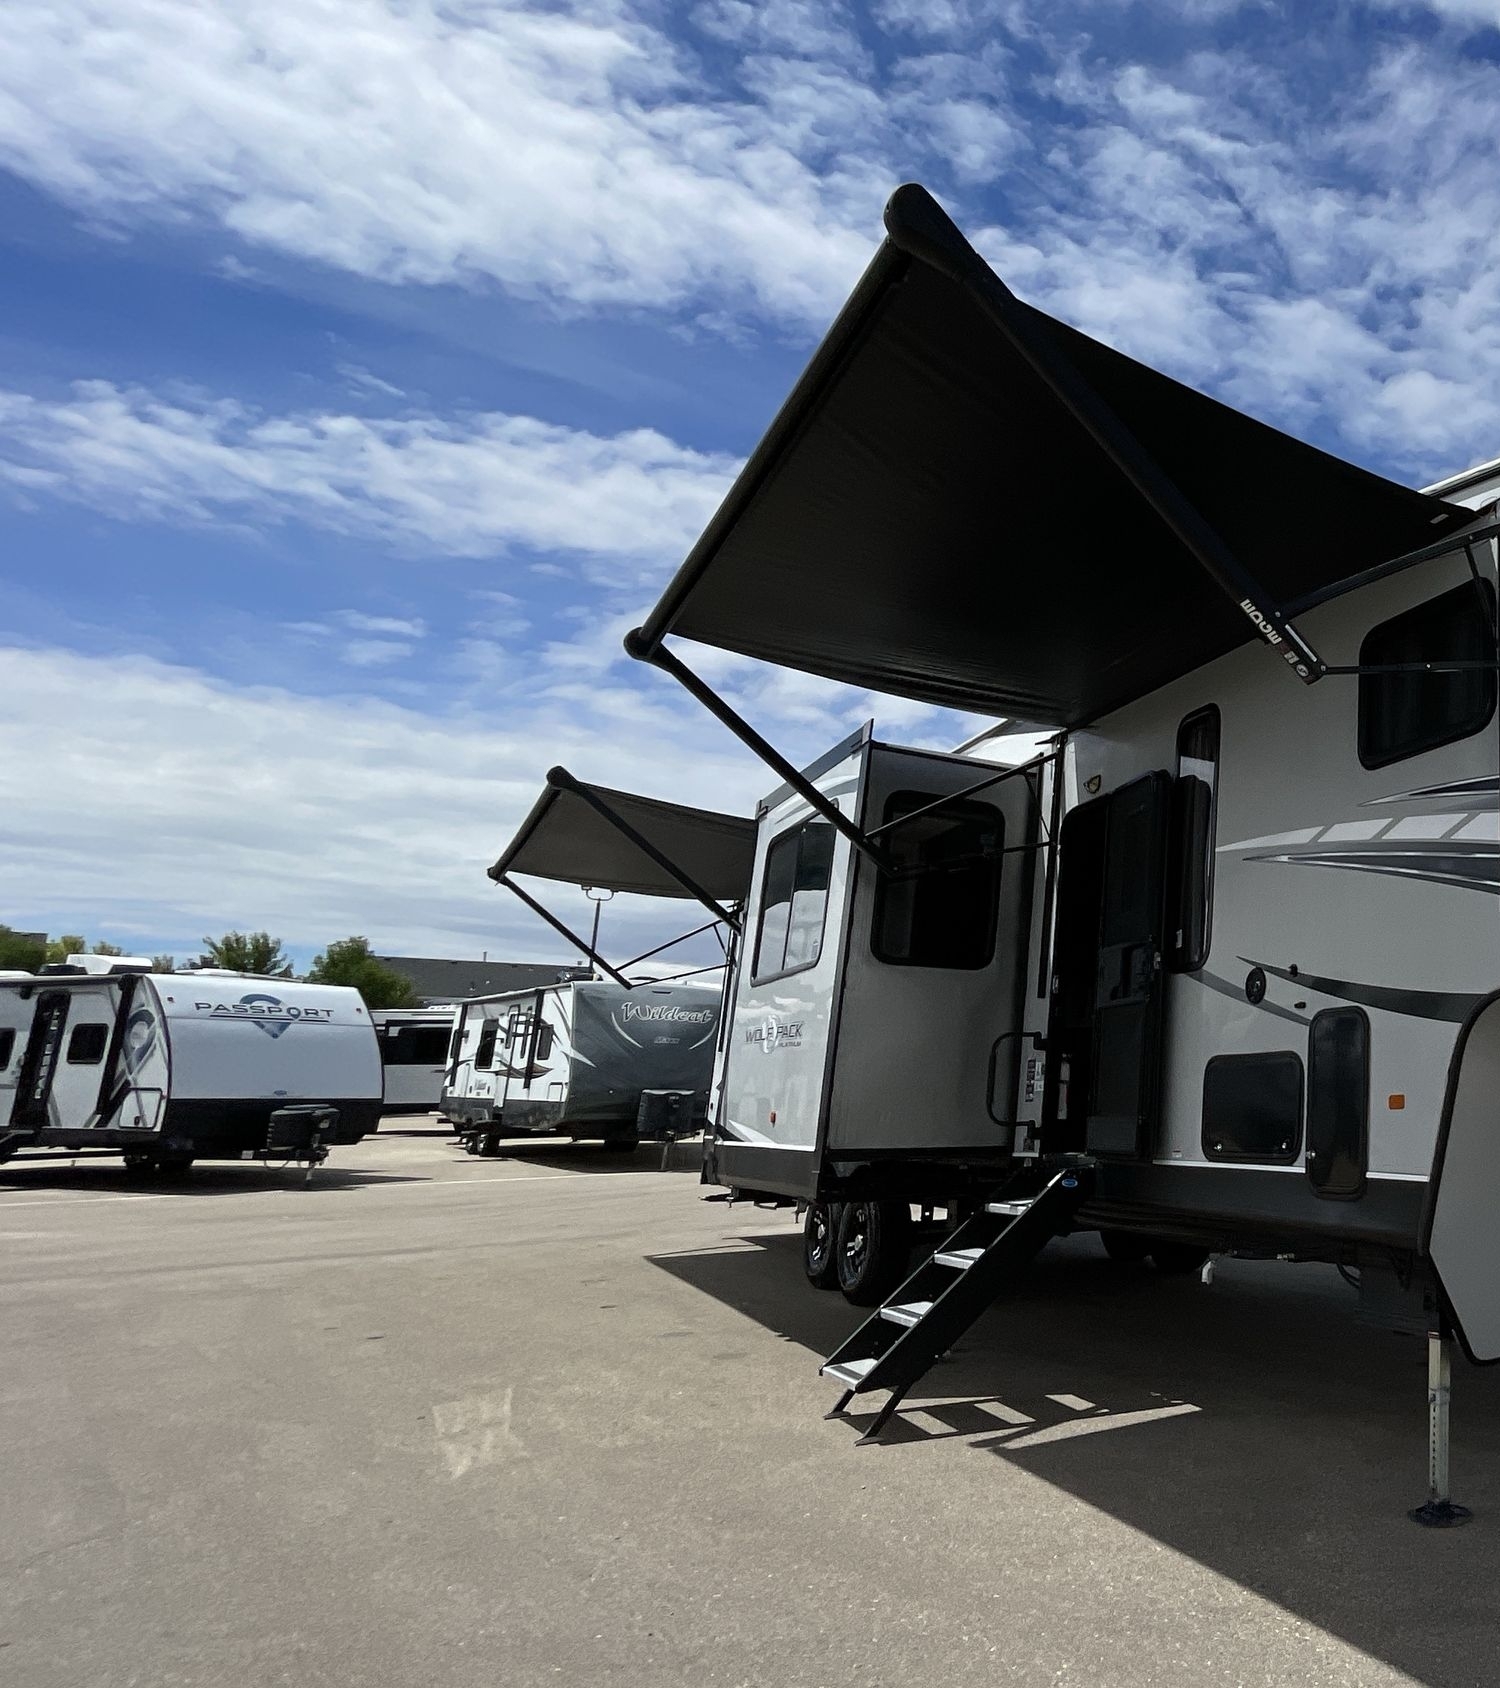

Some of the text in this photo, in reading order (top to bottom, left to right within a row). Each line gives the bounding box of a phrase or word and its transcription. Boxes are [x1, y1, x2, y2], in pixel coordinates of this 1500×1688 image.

[1239, 598, 1282, 645] EDGE
[194, 1002, 335, 1019] PASSPORT
[621, 1001, 714, 1024] Wildcat
[776, 1023, 804, 1040] PACK
